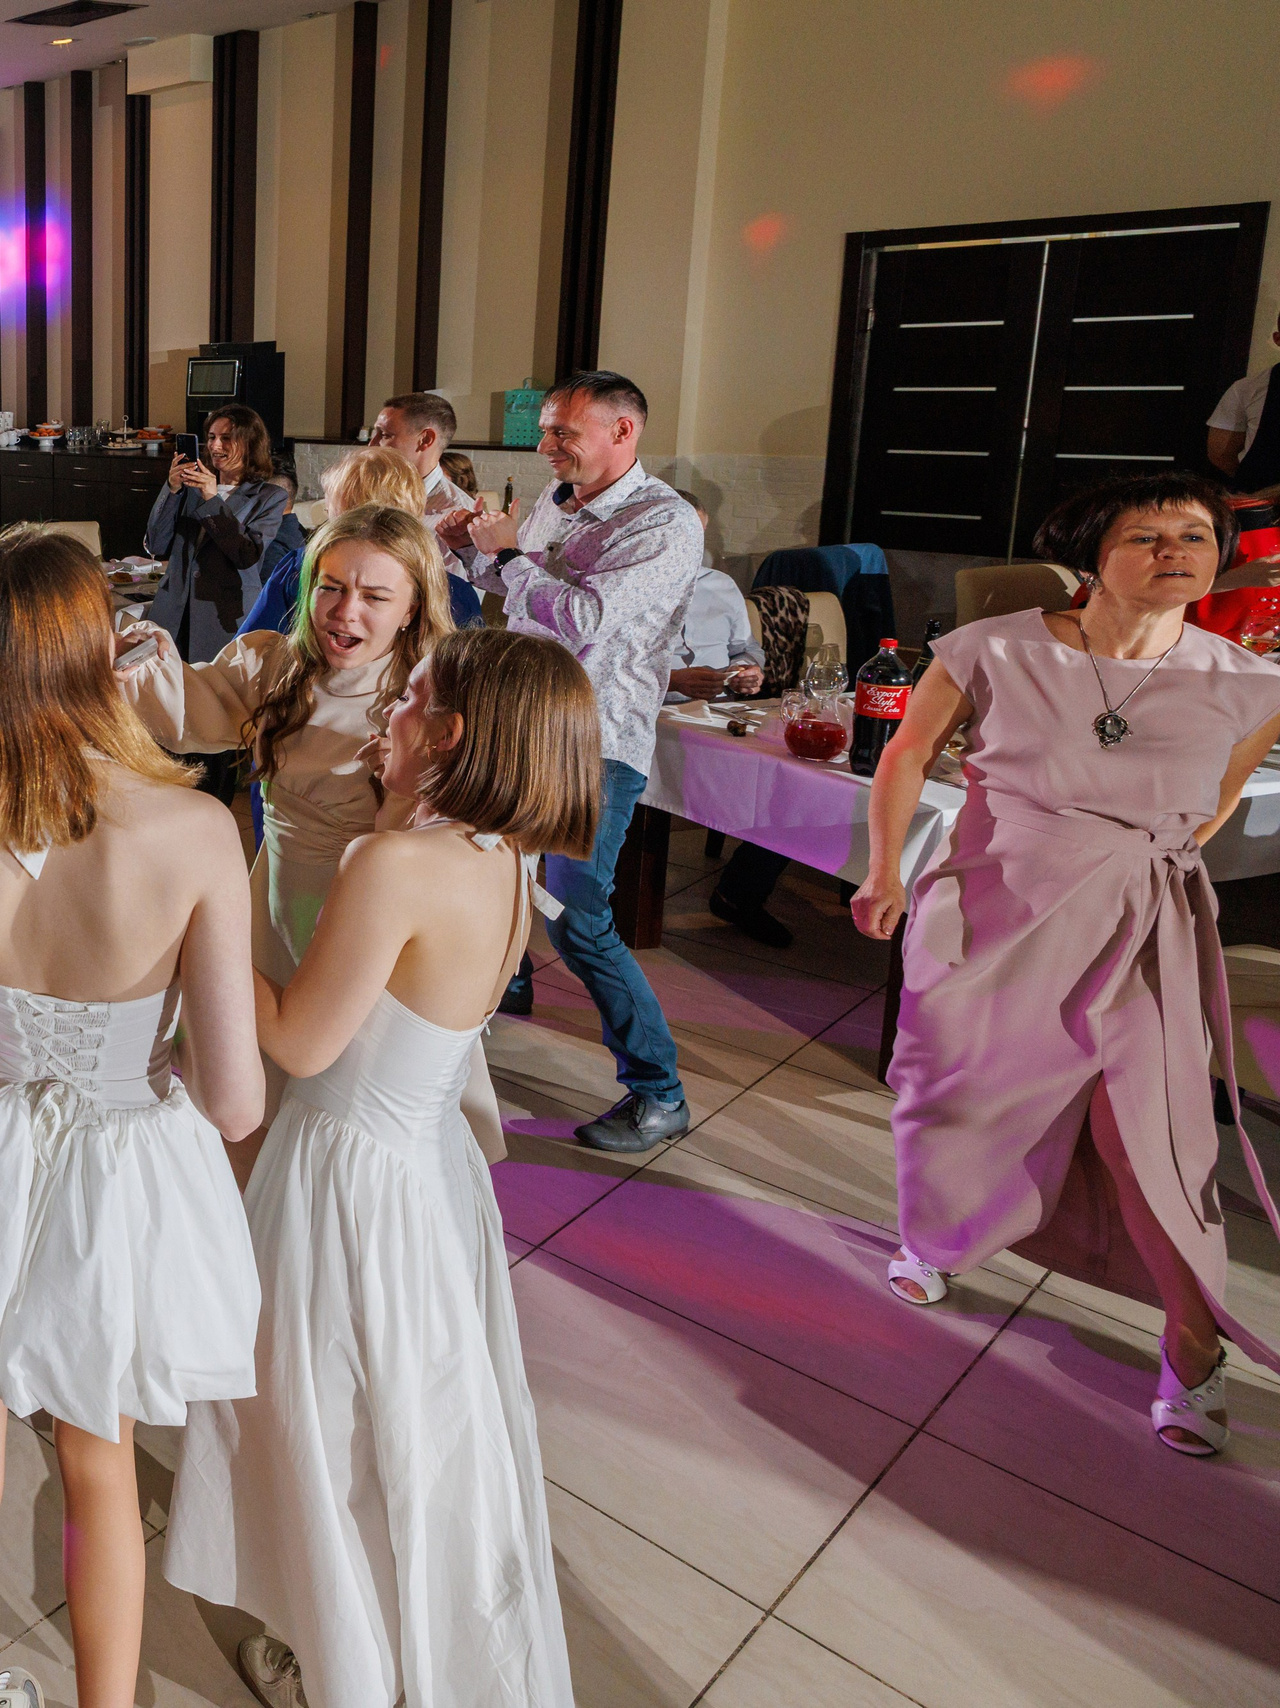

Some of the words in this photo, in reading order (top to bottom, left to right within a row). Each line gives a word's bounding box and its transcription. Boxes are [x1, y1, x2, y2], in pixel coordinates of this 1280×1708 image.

[866, 686, 903, 699] Export
[870, 696, 896, 707] Style
[883, 705, 900, 713] Cola
